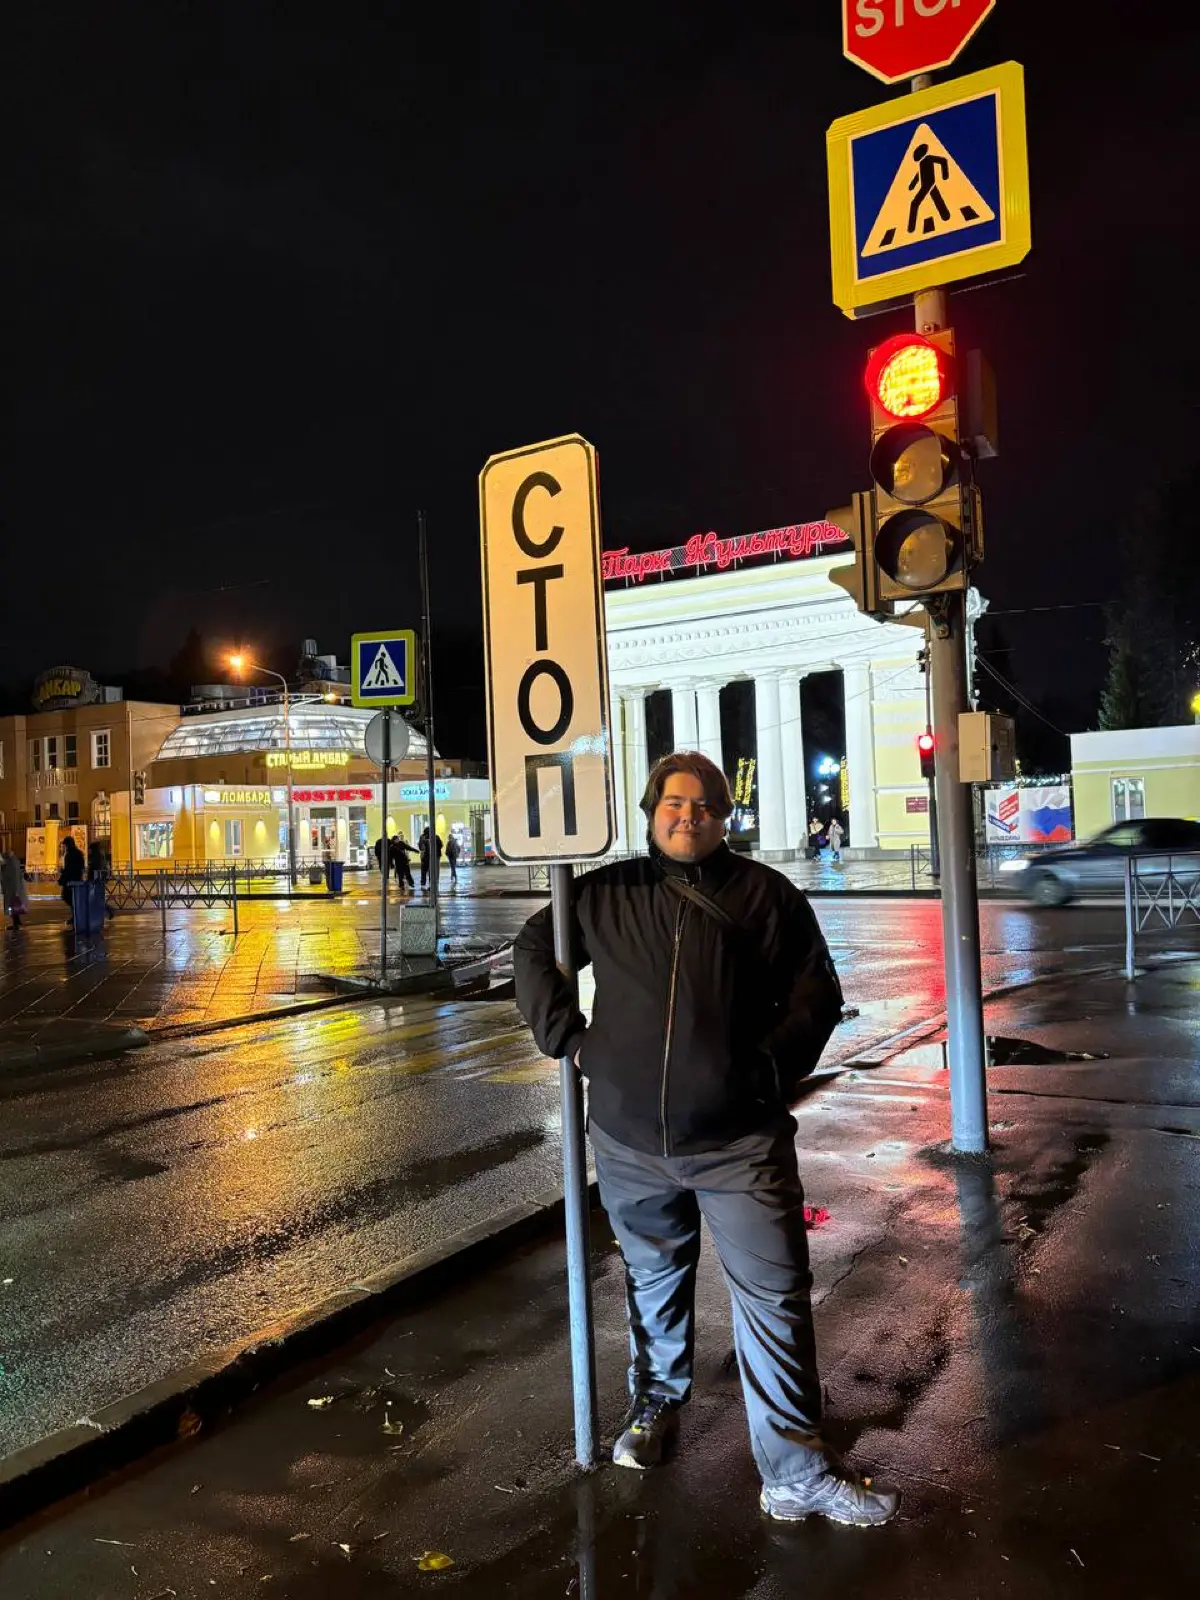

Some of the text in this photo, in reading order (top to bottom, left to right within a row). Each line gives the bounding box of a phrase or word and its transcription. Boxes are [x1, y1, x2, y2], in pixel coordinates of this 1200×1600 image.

[855, 0, 960, 37] ST
[602, 520, 848, 581] Парк Культуры
[512, 471, 578, 838] СТОП
[313, 752, 349, 766] АМБАР
[221, 790, 271, 805] ЛОМБАРД
